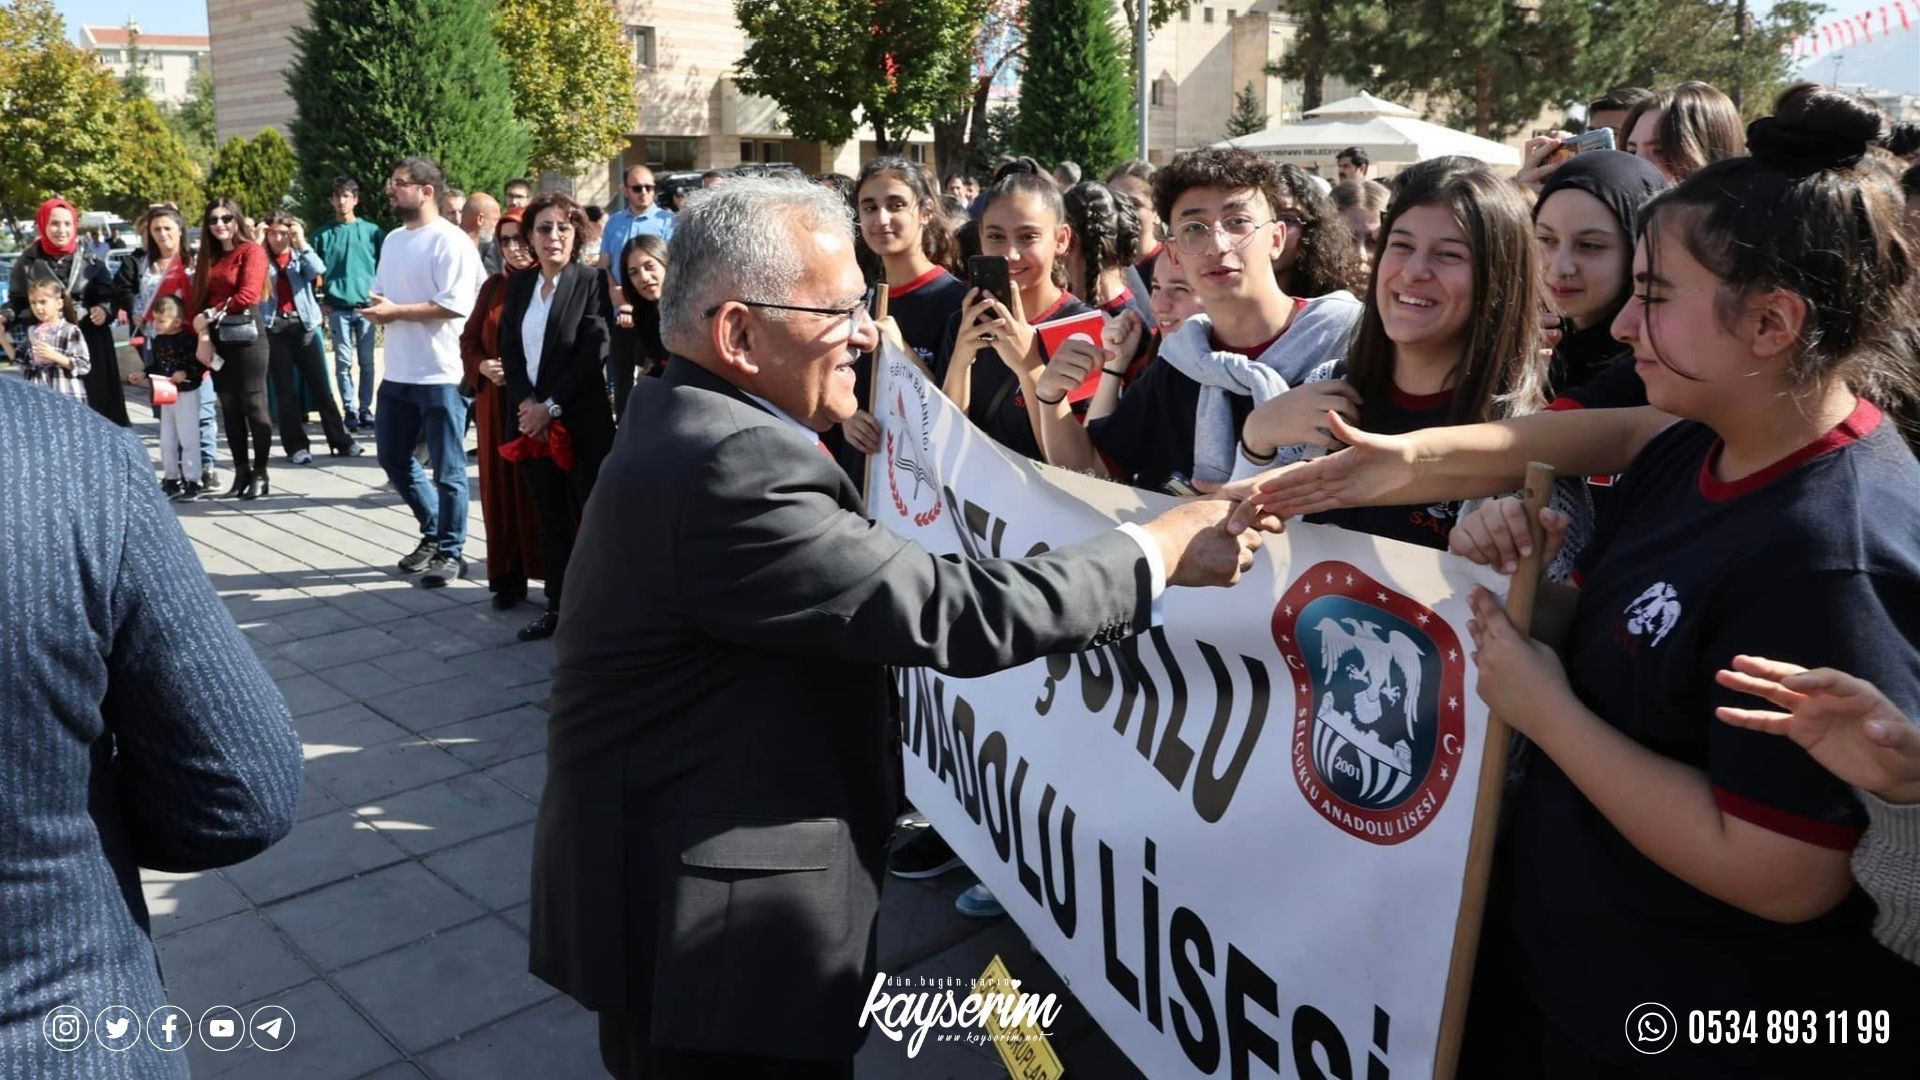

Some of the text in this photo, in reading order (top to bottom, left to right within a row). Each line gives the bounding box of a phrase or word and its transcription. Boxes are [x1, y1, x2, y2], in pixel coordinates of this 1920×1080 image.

[1296, 707, 1438, 837] SELÇUKLU ANADOLU LİSESİ
[1334, 756, 1361, 781] 2001
